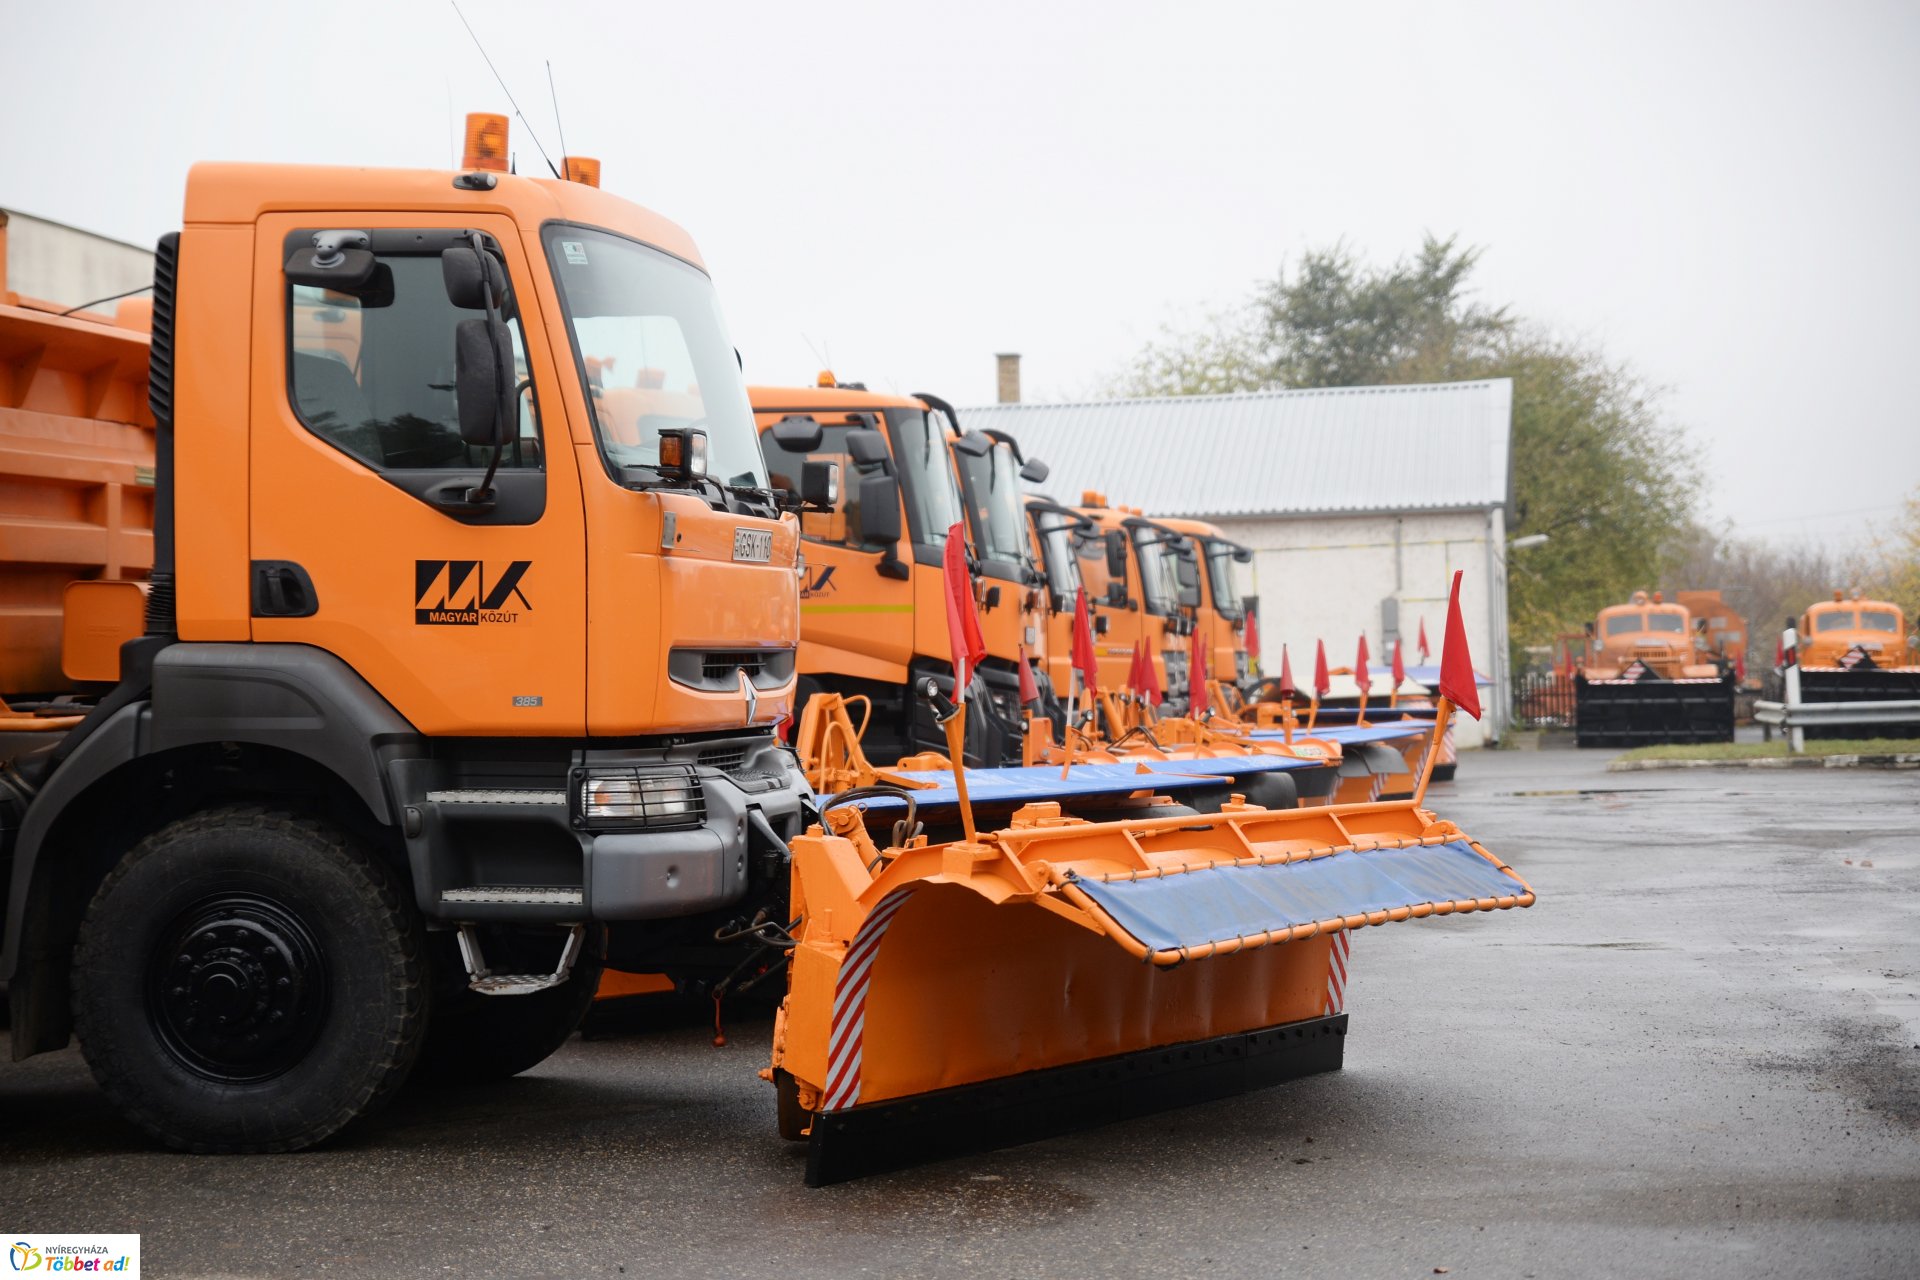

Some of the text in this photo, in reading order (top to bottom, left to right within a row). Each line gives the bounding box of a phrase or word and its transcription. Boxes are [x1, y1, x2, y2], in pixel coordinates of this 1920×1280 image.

[429, 610, 519, 623] MAGYAR KÖZÚT
[515, 697, 537, 706] 385
